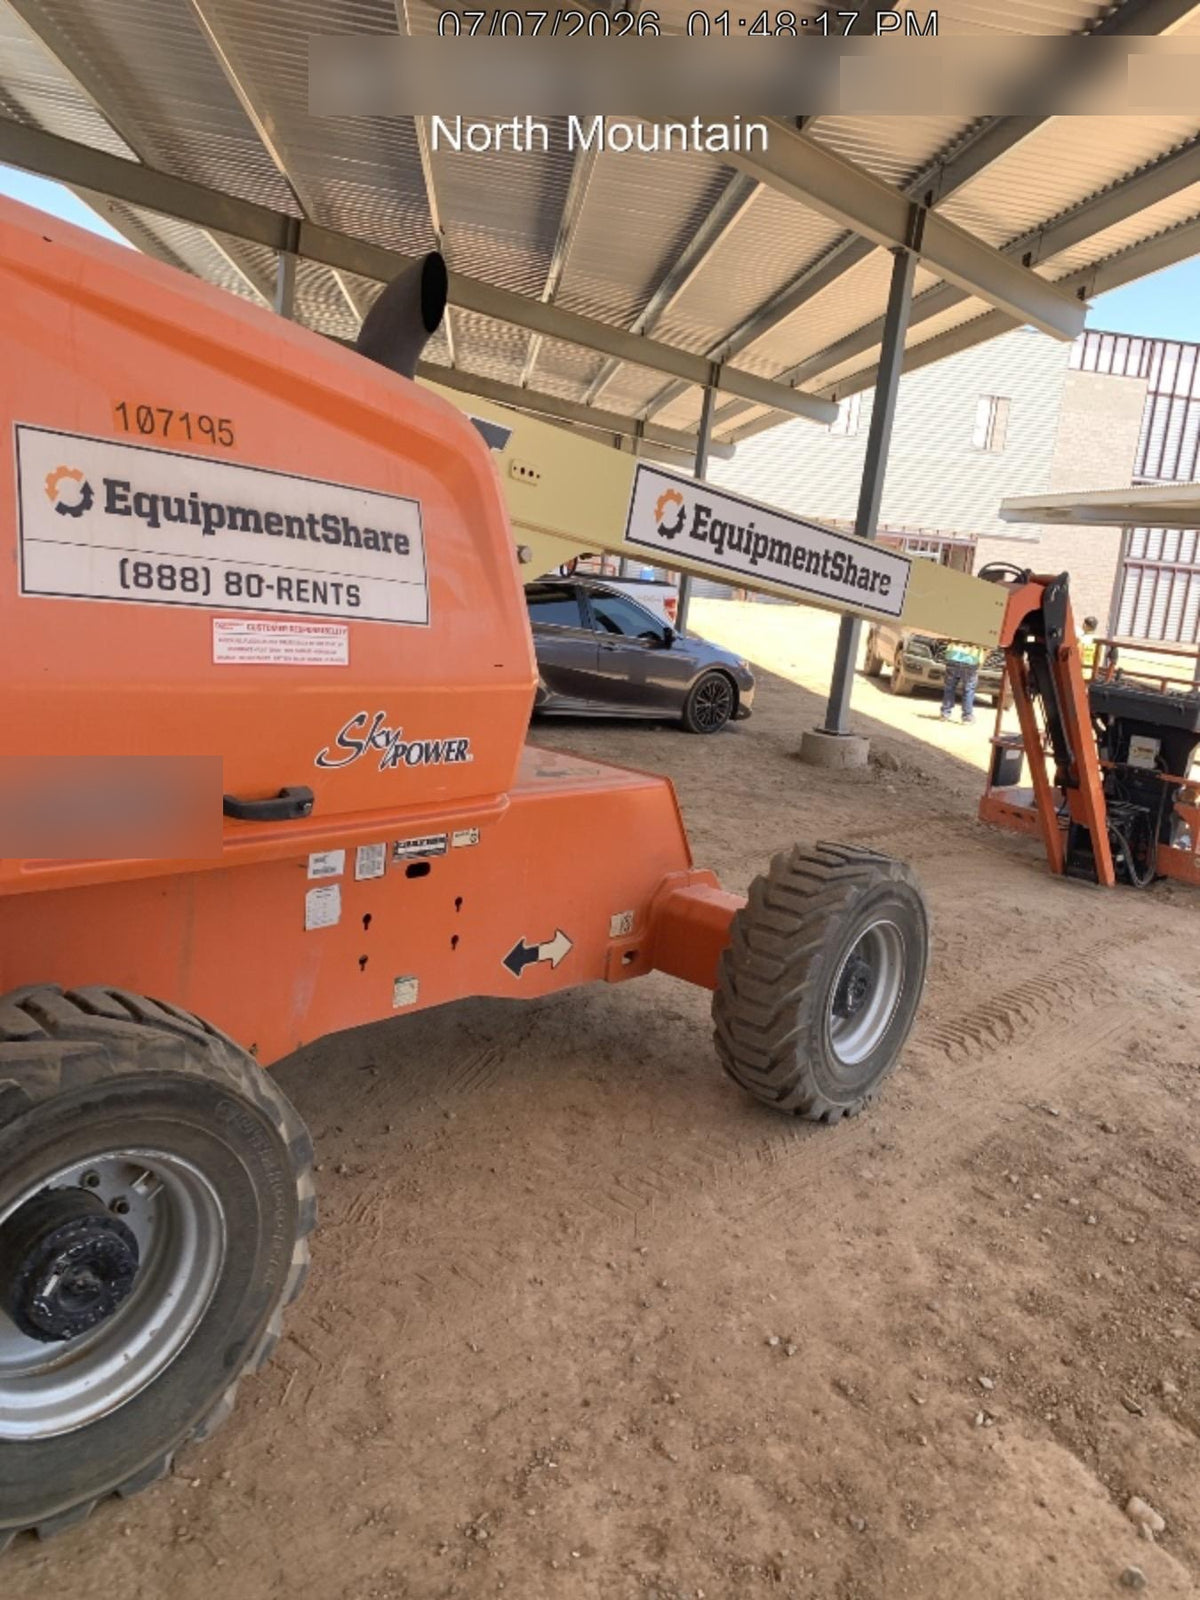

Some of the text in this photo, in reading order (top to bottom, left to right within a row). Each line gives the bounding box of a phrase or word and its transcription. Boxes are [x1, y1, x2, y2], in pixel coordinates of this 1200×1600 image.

[115, 401, 235, 447] 107195
[103, 478, 410, 556] EquipmentShare
[119, 557, 361, 607] (888) 80-RENTS
[689, 503, 892, 597] EquipmentShare
